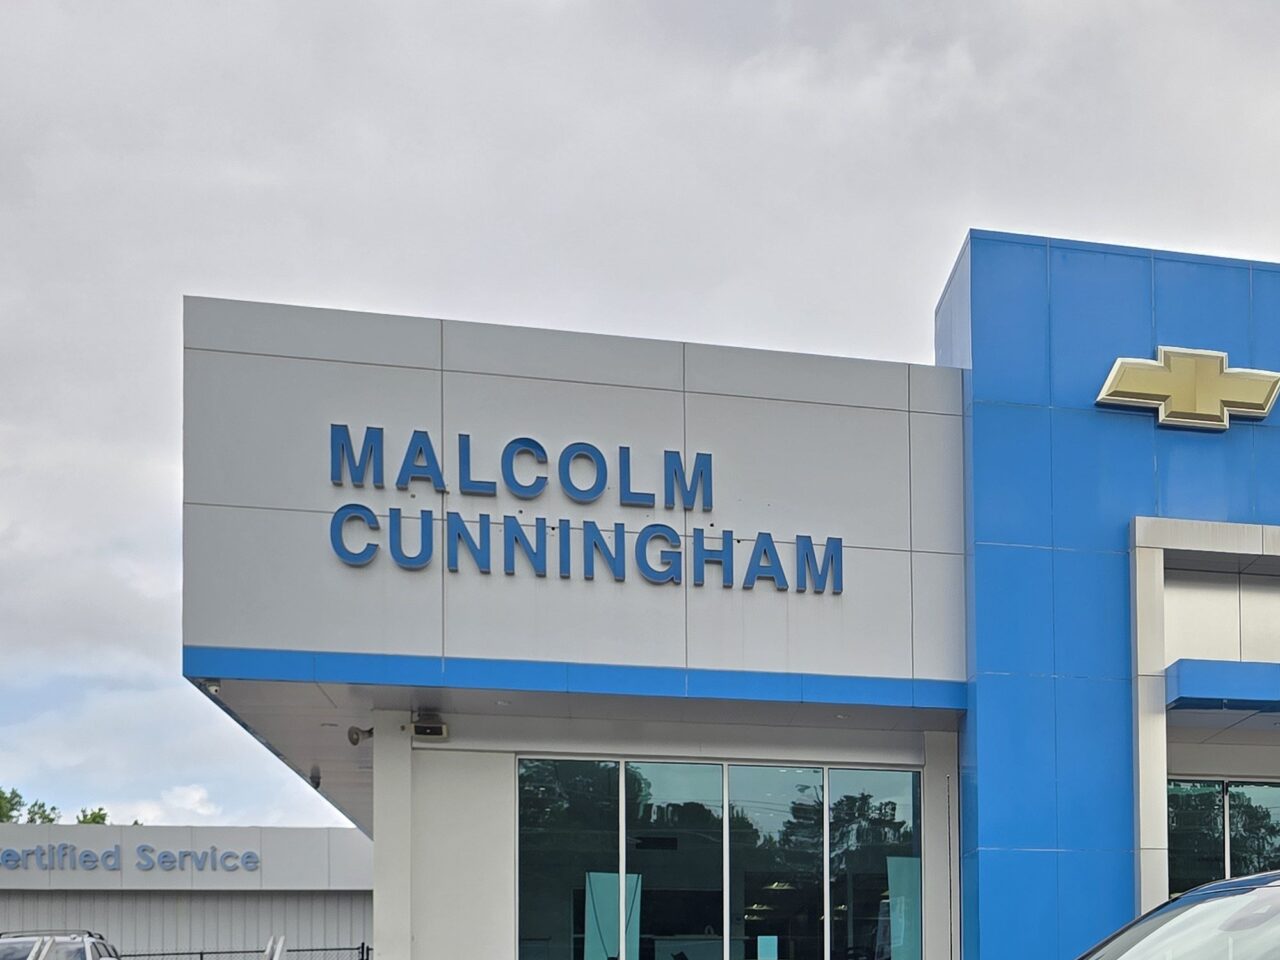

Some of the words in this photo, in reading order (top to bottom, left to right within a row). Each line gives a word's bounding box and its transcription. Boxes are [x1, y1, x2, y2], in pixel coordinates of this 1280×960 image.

[330, 423, 714, 512] MALCOLM
[330, 503, 843, 595] CUNNINGHAM
[135, 844, 260, 872] Service
